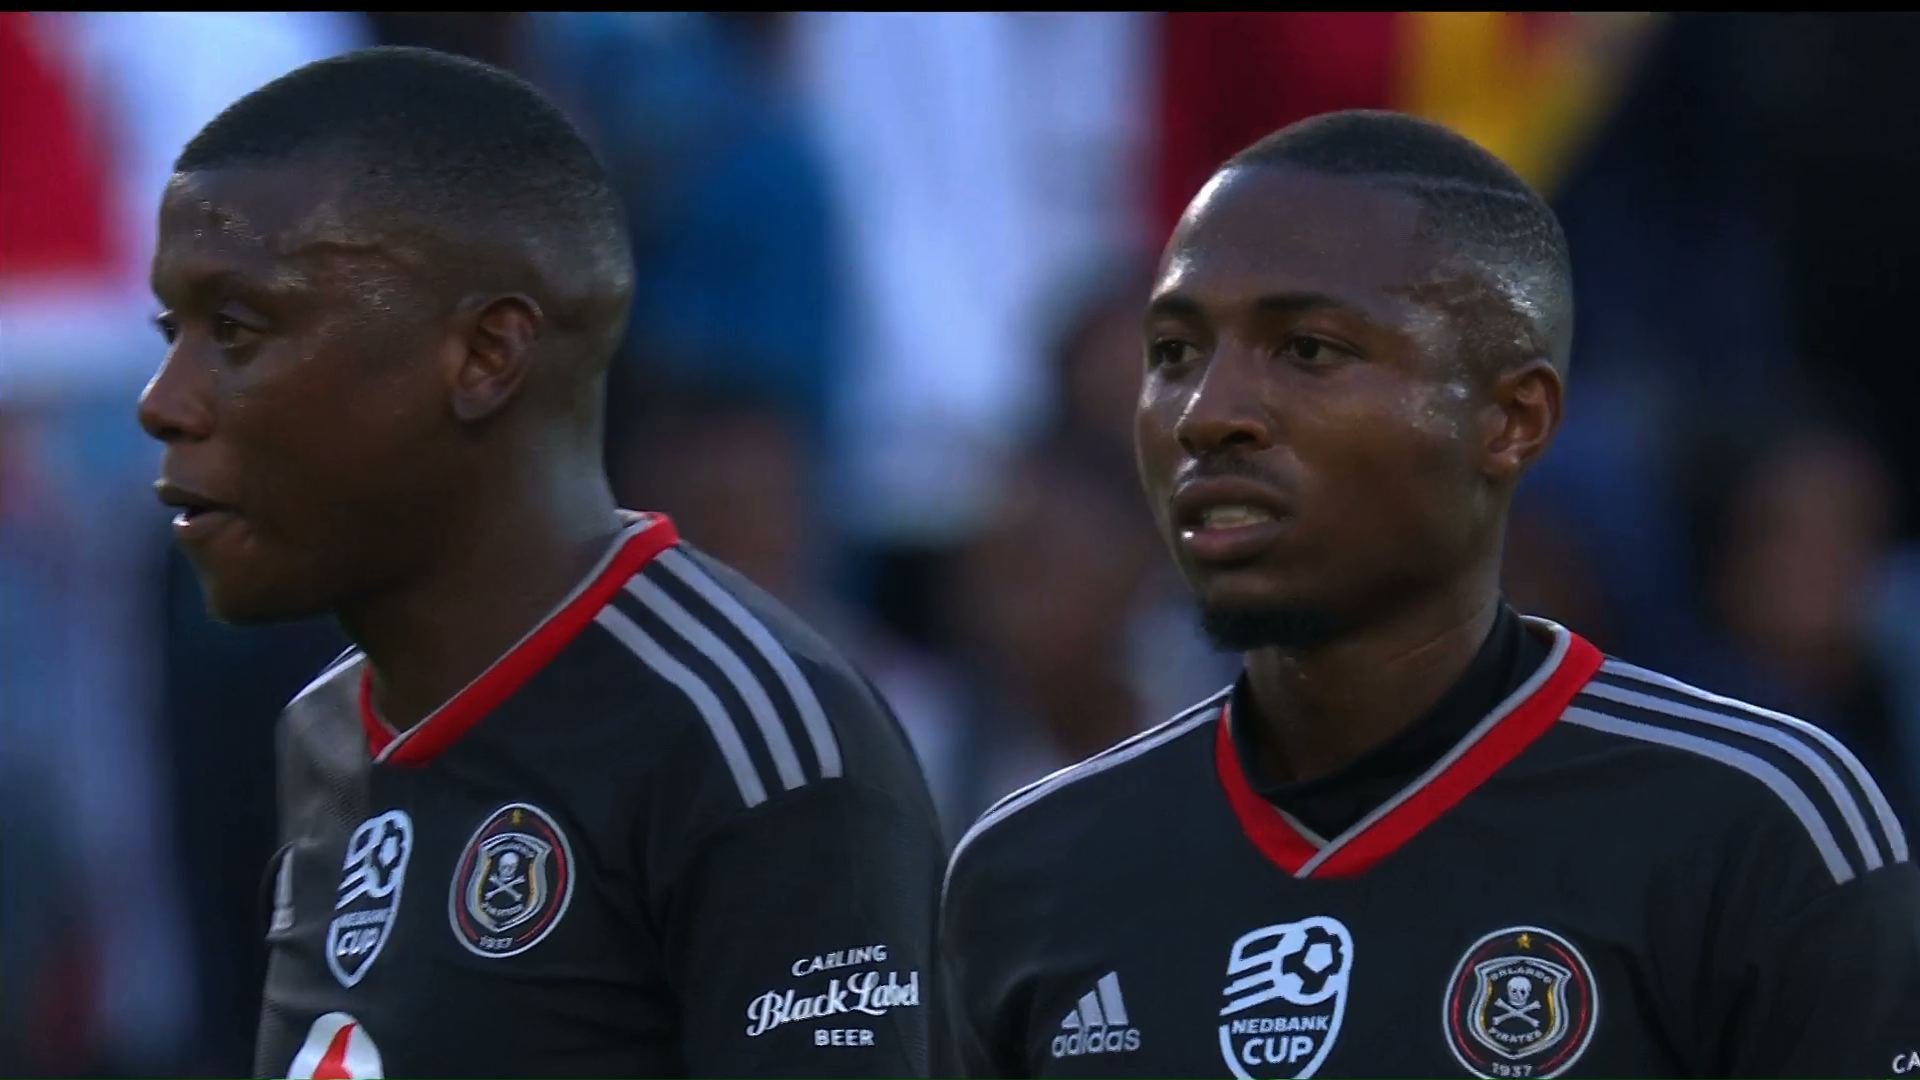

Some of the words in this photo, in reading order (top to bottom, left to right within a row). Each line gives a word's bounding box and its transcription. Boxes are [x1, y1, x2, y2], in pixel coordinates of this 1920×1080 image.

[792, 945, 888, 977] CARLING
[747, 979, 849, 1036] Black
[847, 971, 920, 1016] Label
[814, 1029, 875, 1046] BEER
[1232, 1015, 1329, 1034] NEDBANK
[1052, 1022, 1141, 1058] adidas
[1242, 1035, 1314, 1065] CUP
[1492, 1062, 1533, 1077] 1937
